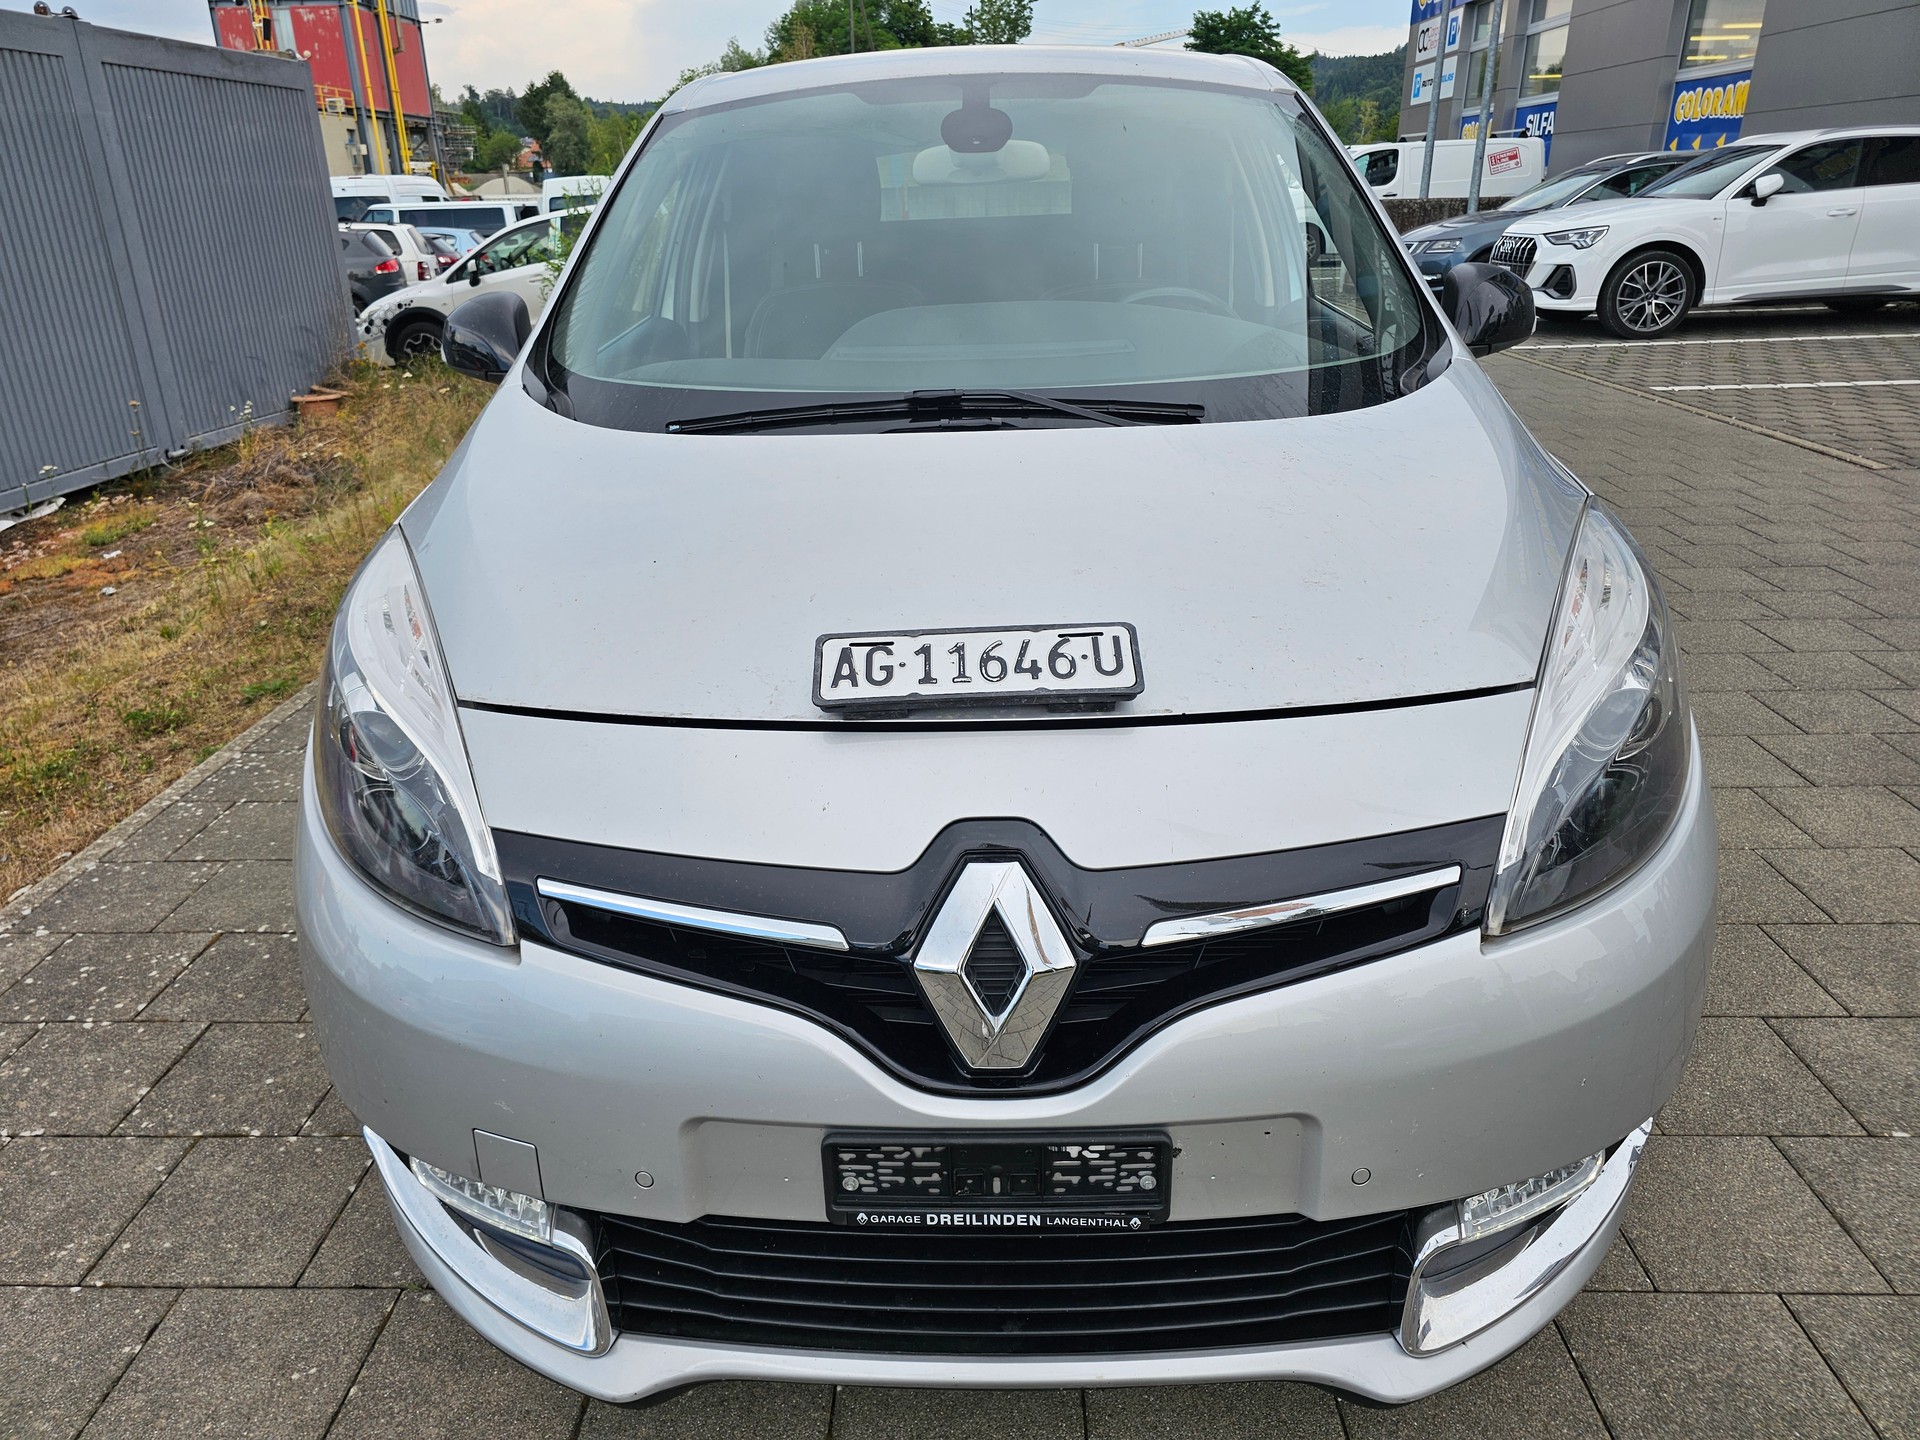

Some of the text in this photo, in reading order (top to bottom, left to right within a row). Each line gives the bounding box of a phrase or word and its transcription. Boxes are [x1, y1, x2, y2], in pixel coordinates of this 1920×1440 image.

[1674, 79, 1751, 125] COLORAM
[1525, 111, 1555, 137] SILFA
[870, 1213, 1129, 1229] GARAGE DREILINDEN LANGENTHAL
